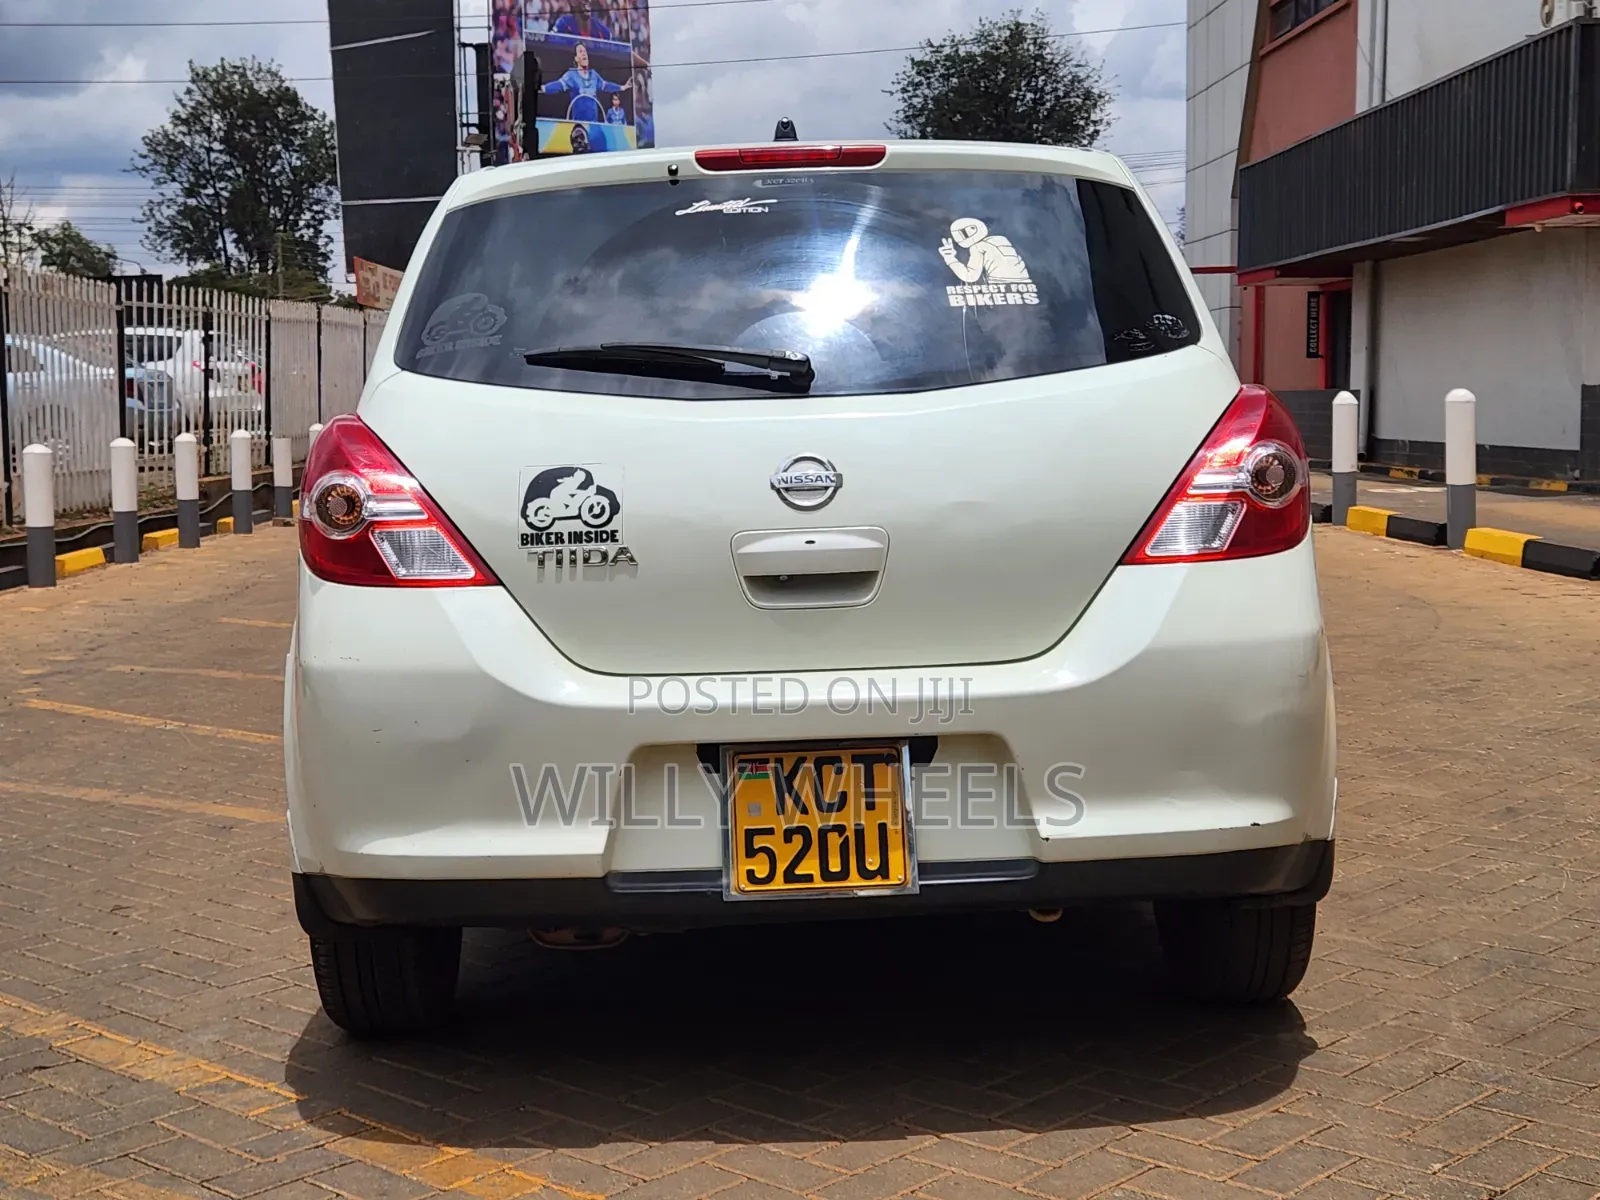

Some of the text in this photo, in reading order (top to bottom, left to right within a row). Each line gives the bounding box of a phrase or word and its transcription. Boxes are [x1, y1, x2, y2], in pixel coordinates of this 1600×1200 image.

[946, 284, 1038, 294] RESPECT FOR
[948, 293, 1040, 306] BIKERS
[1309, 319, 1318, 353] COLLECT
[777, 474, 836, 485] NISSAN
[520, 529, 619, 546] BIKER INSIDE
[527, 546, 638, 568] TIIDA
[774, 753, 899, 817] KCT
[744, 821, 889, 885] 520U
